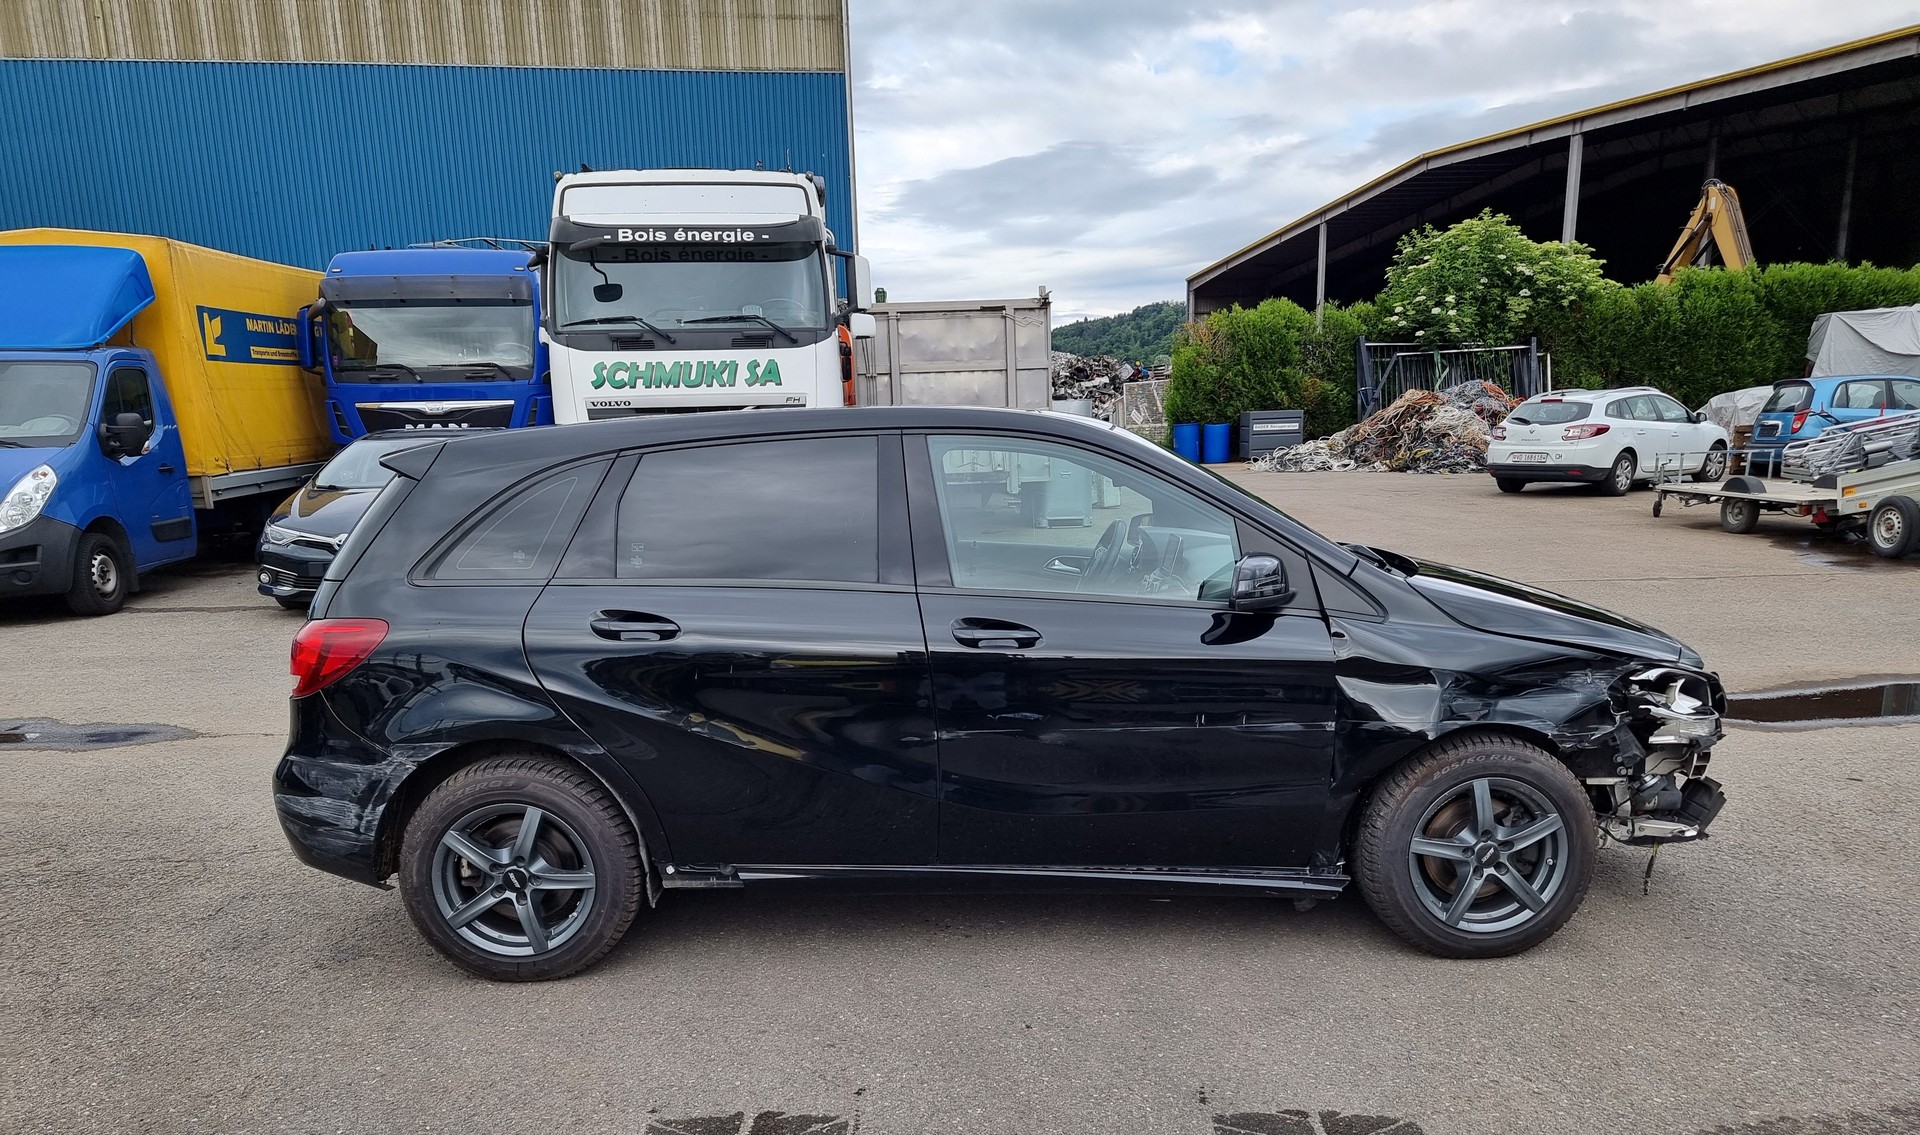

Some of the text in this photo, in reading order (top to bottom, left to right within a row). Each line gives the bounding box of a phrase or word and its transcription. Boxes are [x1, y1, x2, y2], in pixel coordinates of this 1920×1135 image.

[618, 228, 667, 242] Bois
[674, 227, 755, 243] énergie
[245, 318, 275, 334] MARTIN
[591, 358, 783, 390] SCHMUKI SA
[785, 396, 801, 404] FH
[1433, 755, 1486, 781] 205/60
